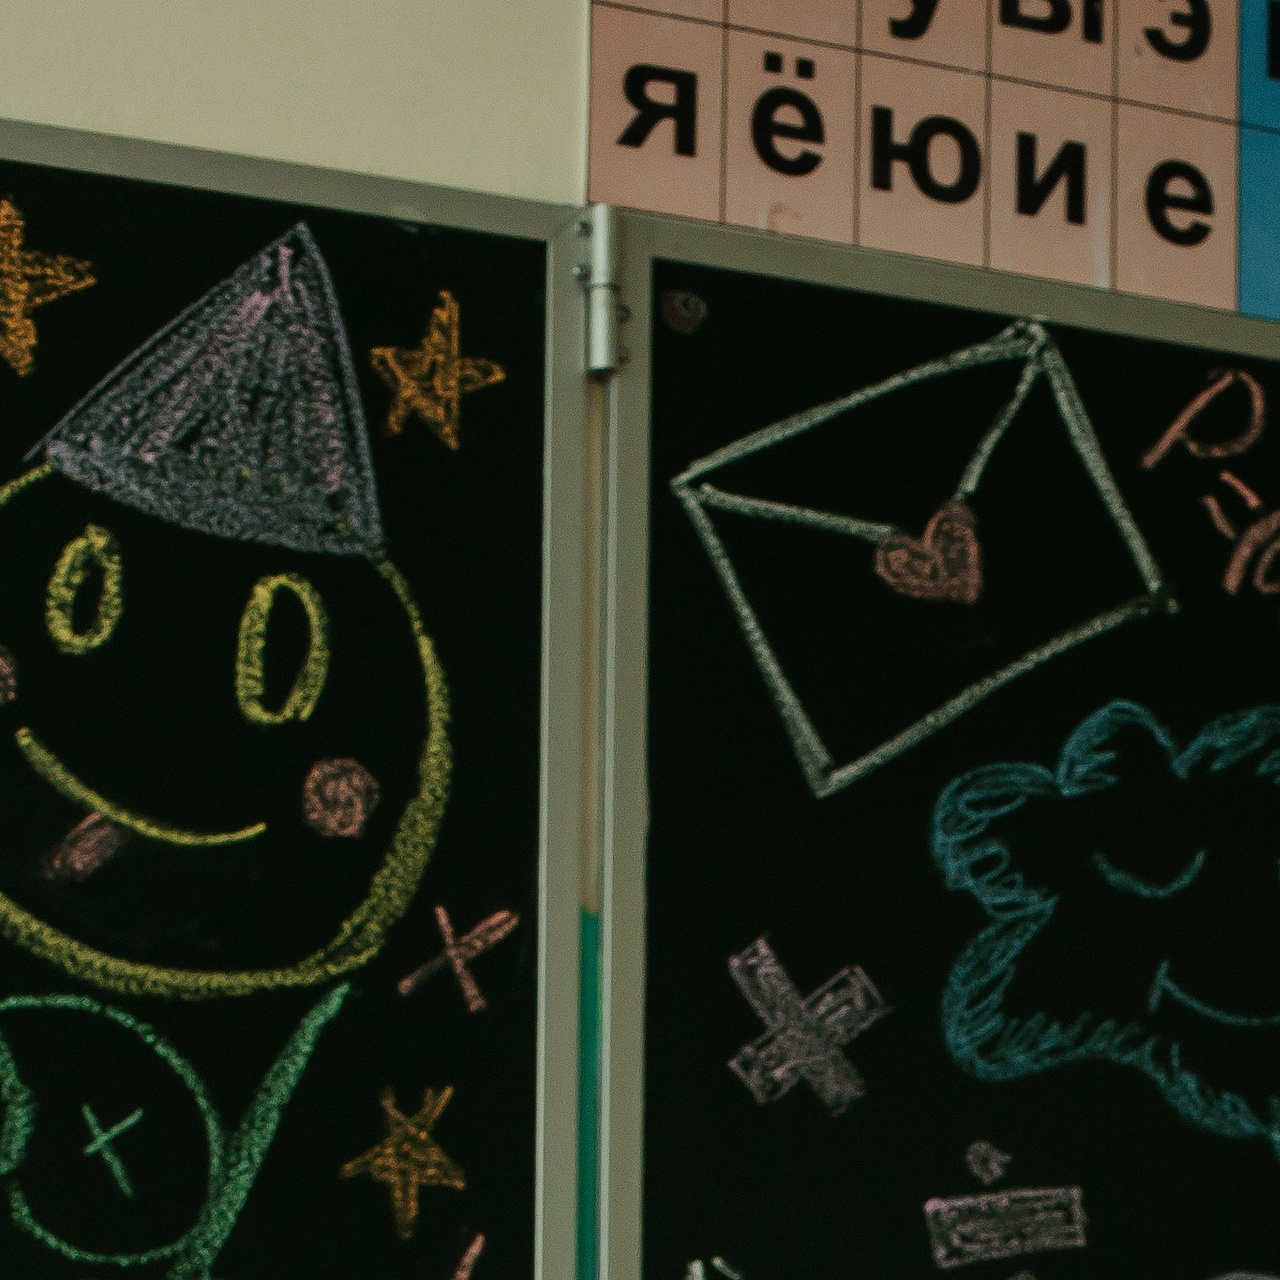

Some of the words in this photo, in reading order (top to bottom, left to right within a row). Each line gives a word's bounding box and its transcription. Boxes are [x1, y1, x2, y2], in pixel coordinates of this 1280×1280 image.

[618, 64, 697, 157] я
[750, 52, 825, 176] ё
[871, 105, 982, 204] ю
[1016, 132, 1087, 225] и
[1145, 159, 1214, 246] е
